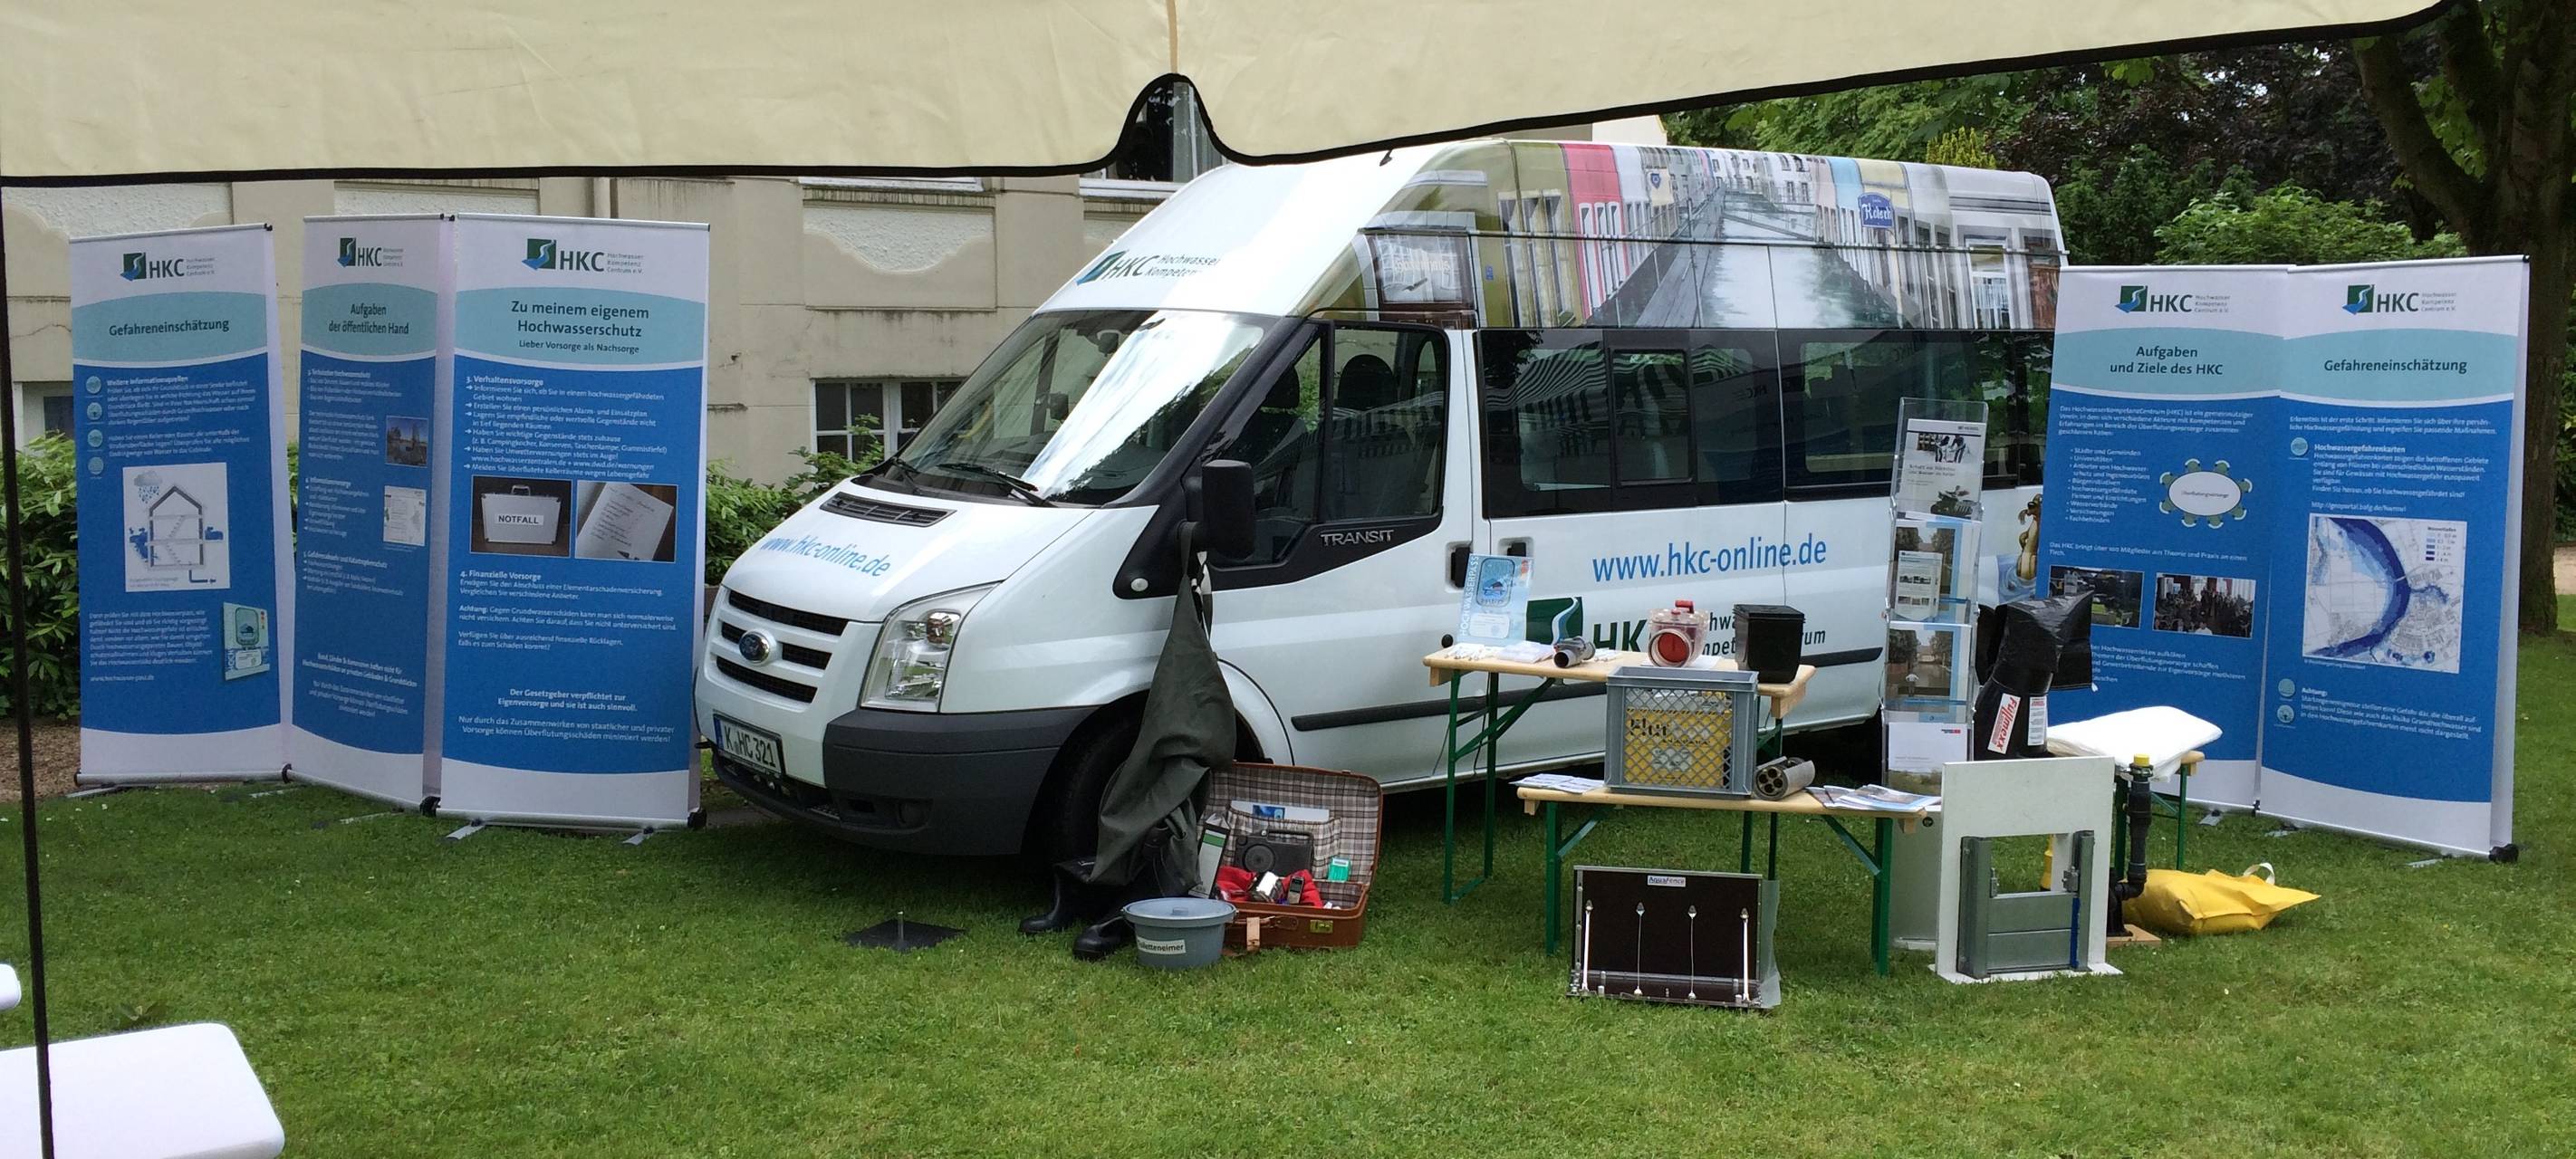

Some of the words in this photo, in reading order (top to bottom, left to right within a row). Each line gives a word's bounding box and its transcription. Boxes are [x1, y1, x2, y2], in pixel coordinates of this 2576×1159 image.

[358, 247, 382, 266] HKC
[560, 251, 604, 272] HKC
[149, 259, 185, 279] HKC
[1101, 255, 1160, 281] HKC
[351, 303, 386, 317] Aufgaben
[2150, 295, 2192, 312] HKC
[2377, 292, 2418, 312] HKC
[511, 301, 527, 312] Zu
[533, 302, 587, 316] meinem
[591, 305, 649, 321] eigenem
[110, 319, 229, 336] Gefahreneinschätzung
[329, 321, 340, 331] der
[342, 321, 386, 333] öffentlichen
[389, 323, 409, 334] Hand
[518, 321, 641, 337] Hochwasserschutz
[519, 340, 543, 349] Lieber
[546, 341, 581, 351] Vorsorge
[583, 342, 594, 350] als
[597, 344, 639, 354] Nachsorge
[2137, 346, 2197, 359] Aufgaben
[2110, 363, 2133, 373] und
[2138, 363, 2167, 373] Ziele
[2171, 363, 2191, 374] des
[2196, 364, 2224, 375] HKC
[2324, 359, 2467, 374] Gefahreneinschätzung
[474, 377, 543, 386] Verhaltensvorsorge
[498, 515, 539, 523] NOTFALL
[1321, 530, 1394, 546] TRANSIT
[760, 535, 892, 577] www.hkc-online.de
[1593, 533, 1827, 582] www.hkc-online.de
[468, 570, 507, 579] Finanzielle
[509, 572, 542, 580] Vorsorge
[1593, 619, 1646, 651] HK
[498, 698, 549, 708] Eigenvorsorge
[524, 689, 569, 699] Gesetzgeber
[571, 691, 611, 701] verpflichtet
[463, 725, 494, 735] Vorsorge
[524, 728, 601, 740] Überflutungsschäden
[602, 732, 639, 740] minimiert
[510, 718, 574, 727] Zusammenwirken
[591, 722, 629, 730] staatlicher
[646, 724, 674, 733] privater
[725, 726, 733, 751] K
[737, 731, 753, 758] HC
[754, 737, 776, 767] 321
